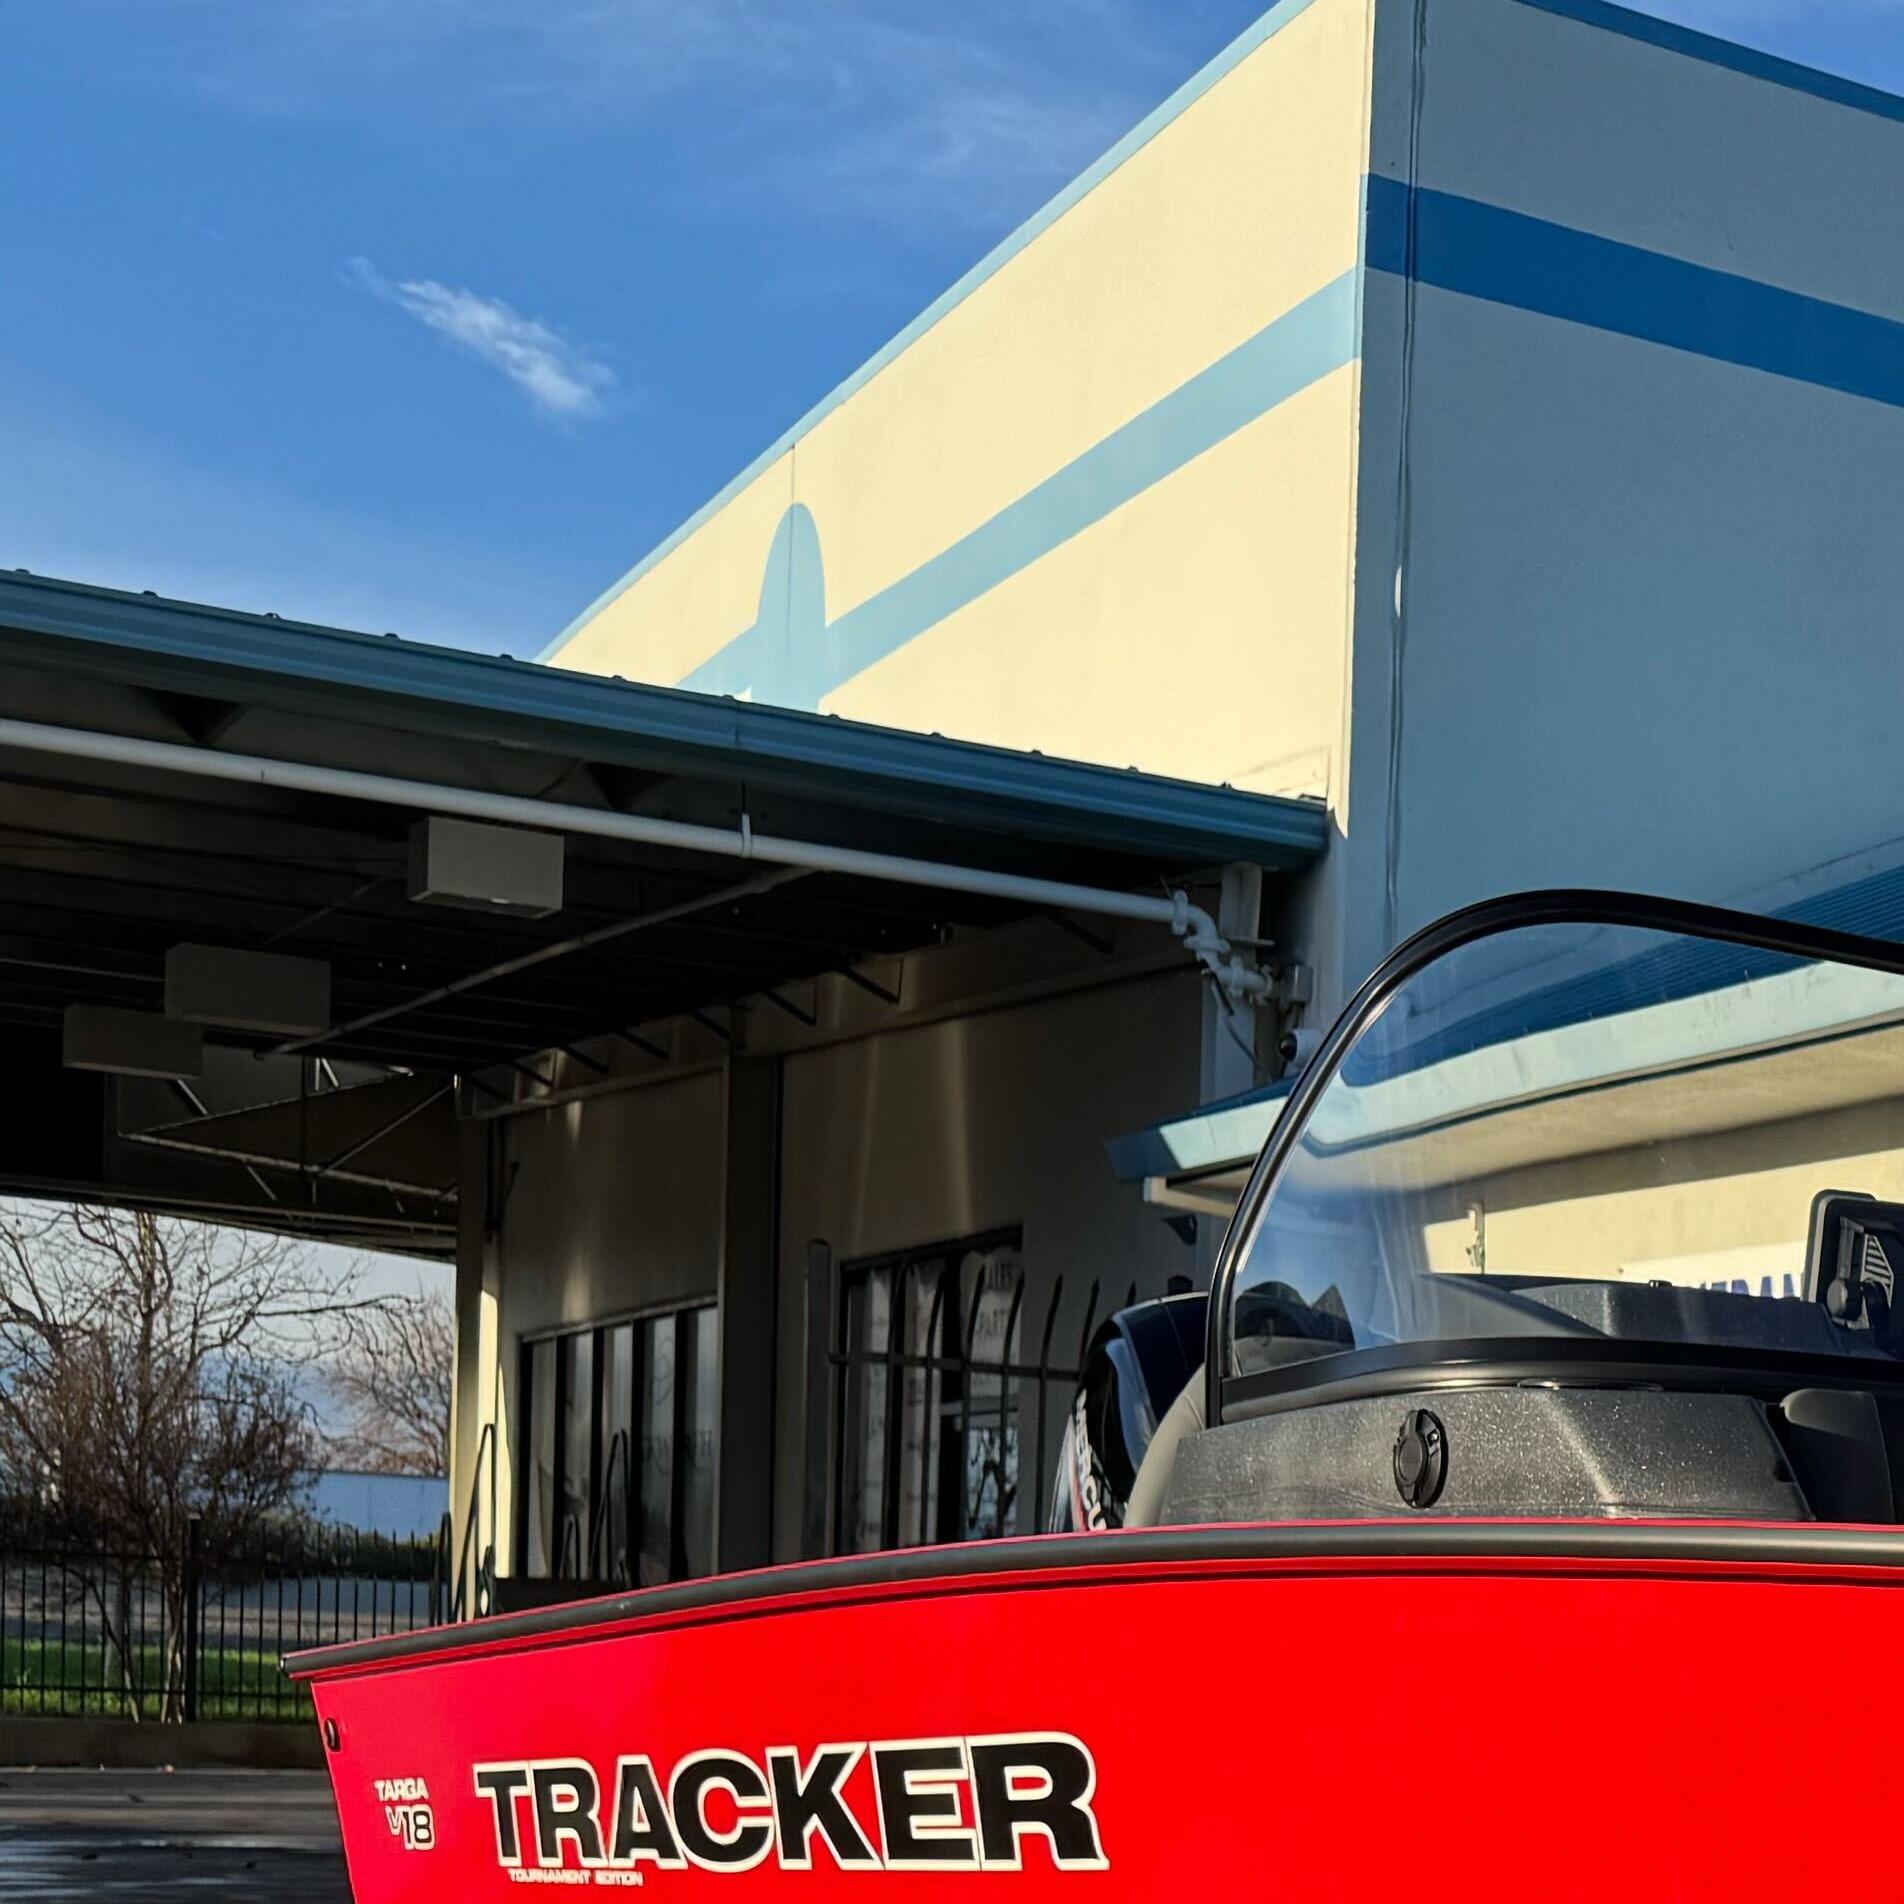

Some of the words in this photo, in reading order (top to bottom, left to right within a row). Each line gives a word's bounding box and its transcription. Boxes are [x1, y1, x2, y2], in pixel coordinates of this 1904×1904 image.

[374, 1778, 428, 1801] TARGA
[473, 1730, 1110, 1872] TRACKER
[385, 1804, 435, 1850] V18
[508, 1868, 591, 1884] TOURNAMENT
[594, 1869, 643, 1886] EDITION
